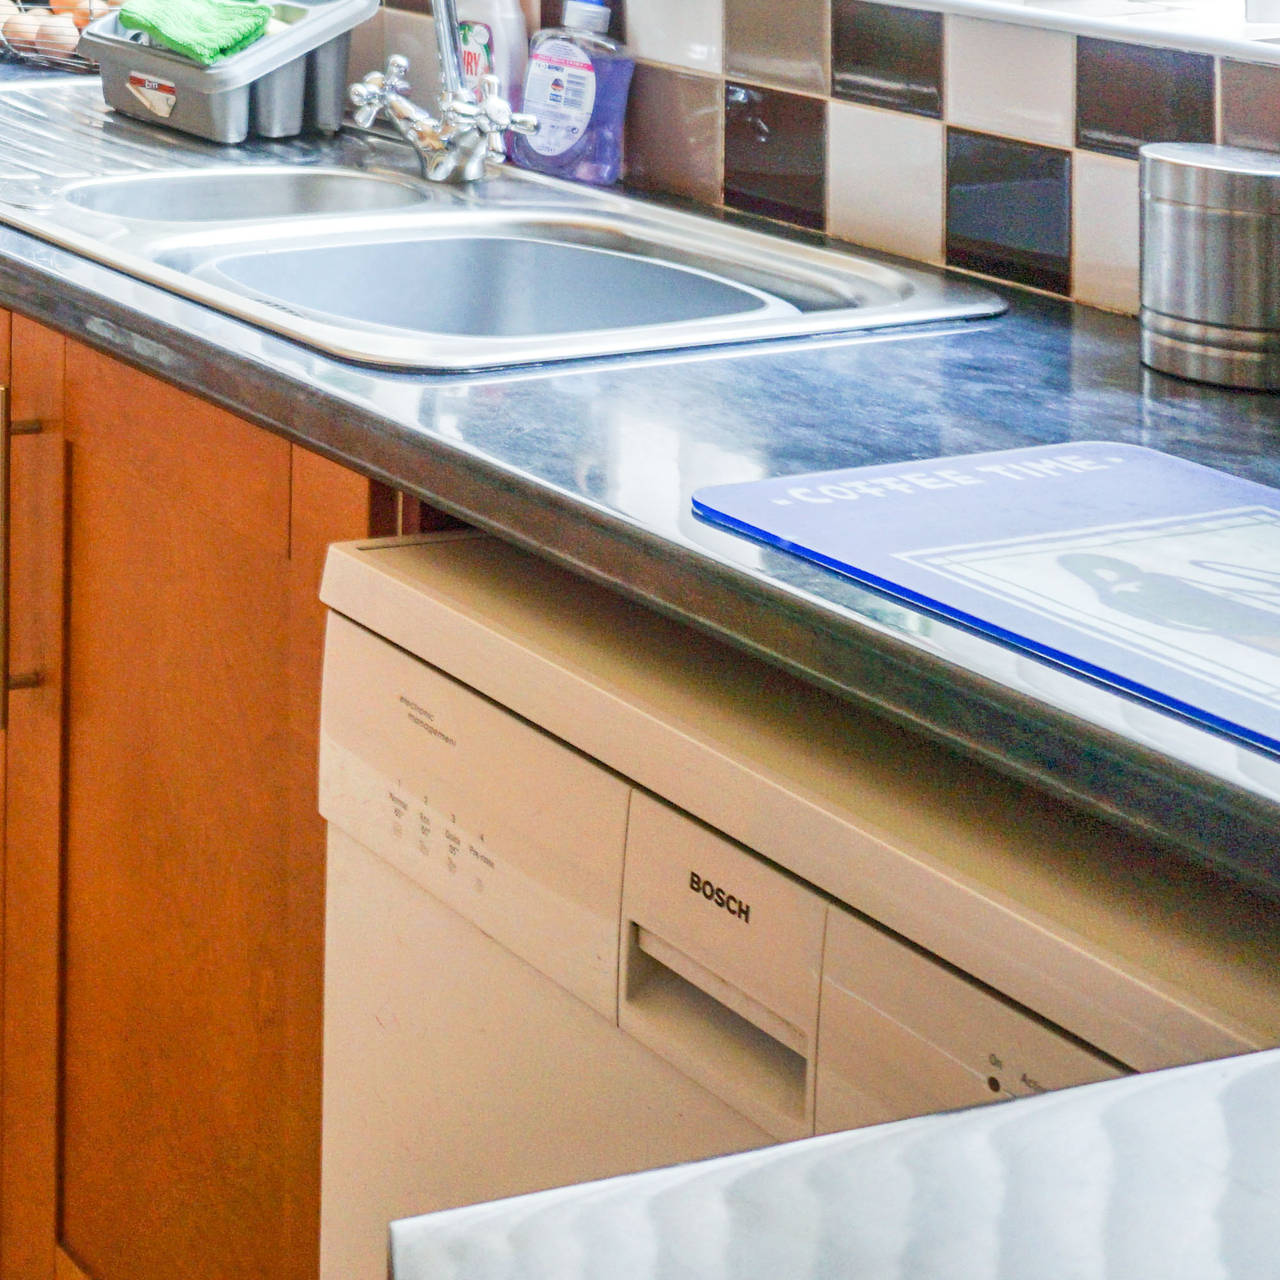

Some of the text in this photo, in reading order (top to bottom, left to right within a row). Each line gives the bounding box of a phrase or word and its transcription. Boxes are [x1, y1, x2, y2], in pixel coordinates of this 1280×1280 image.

[786, 454, 1108, 505] COFFEE TIME
[689, 871, 750, 924] BOSCH
